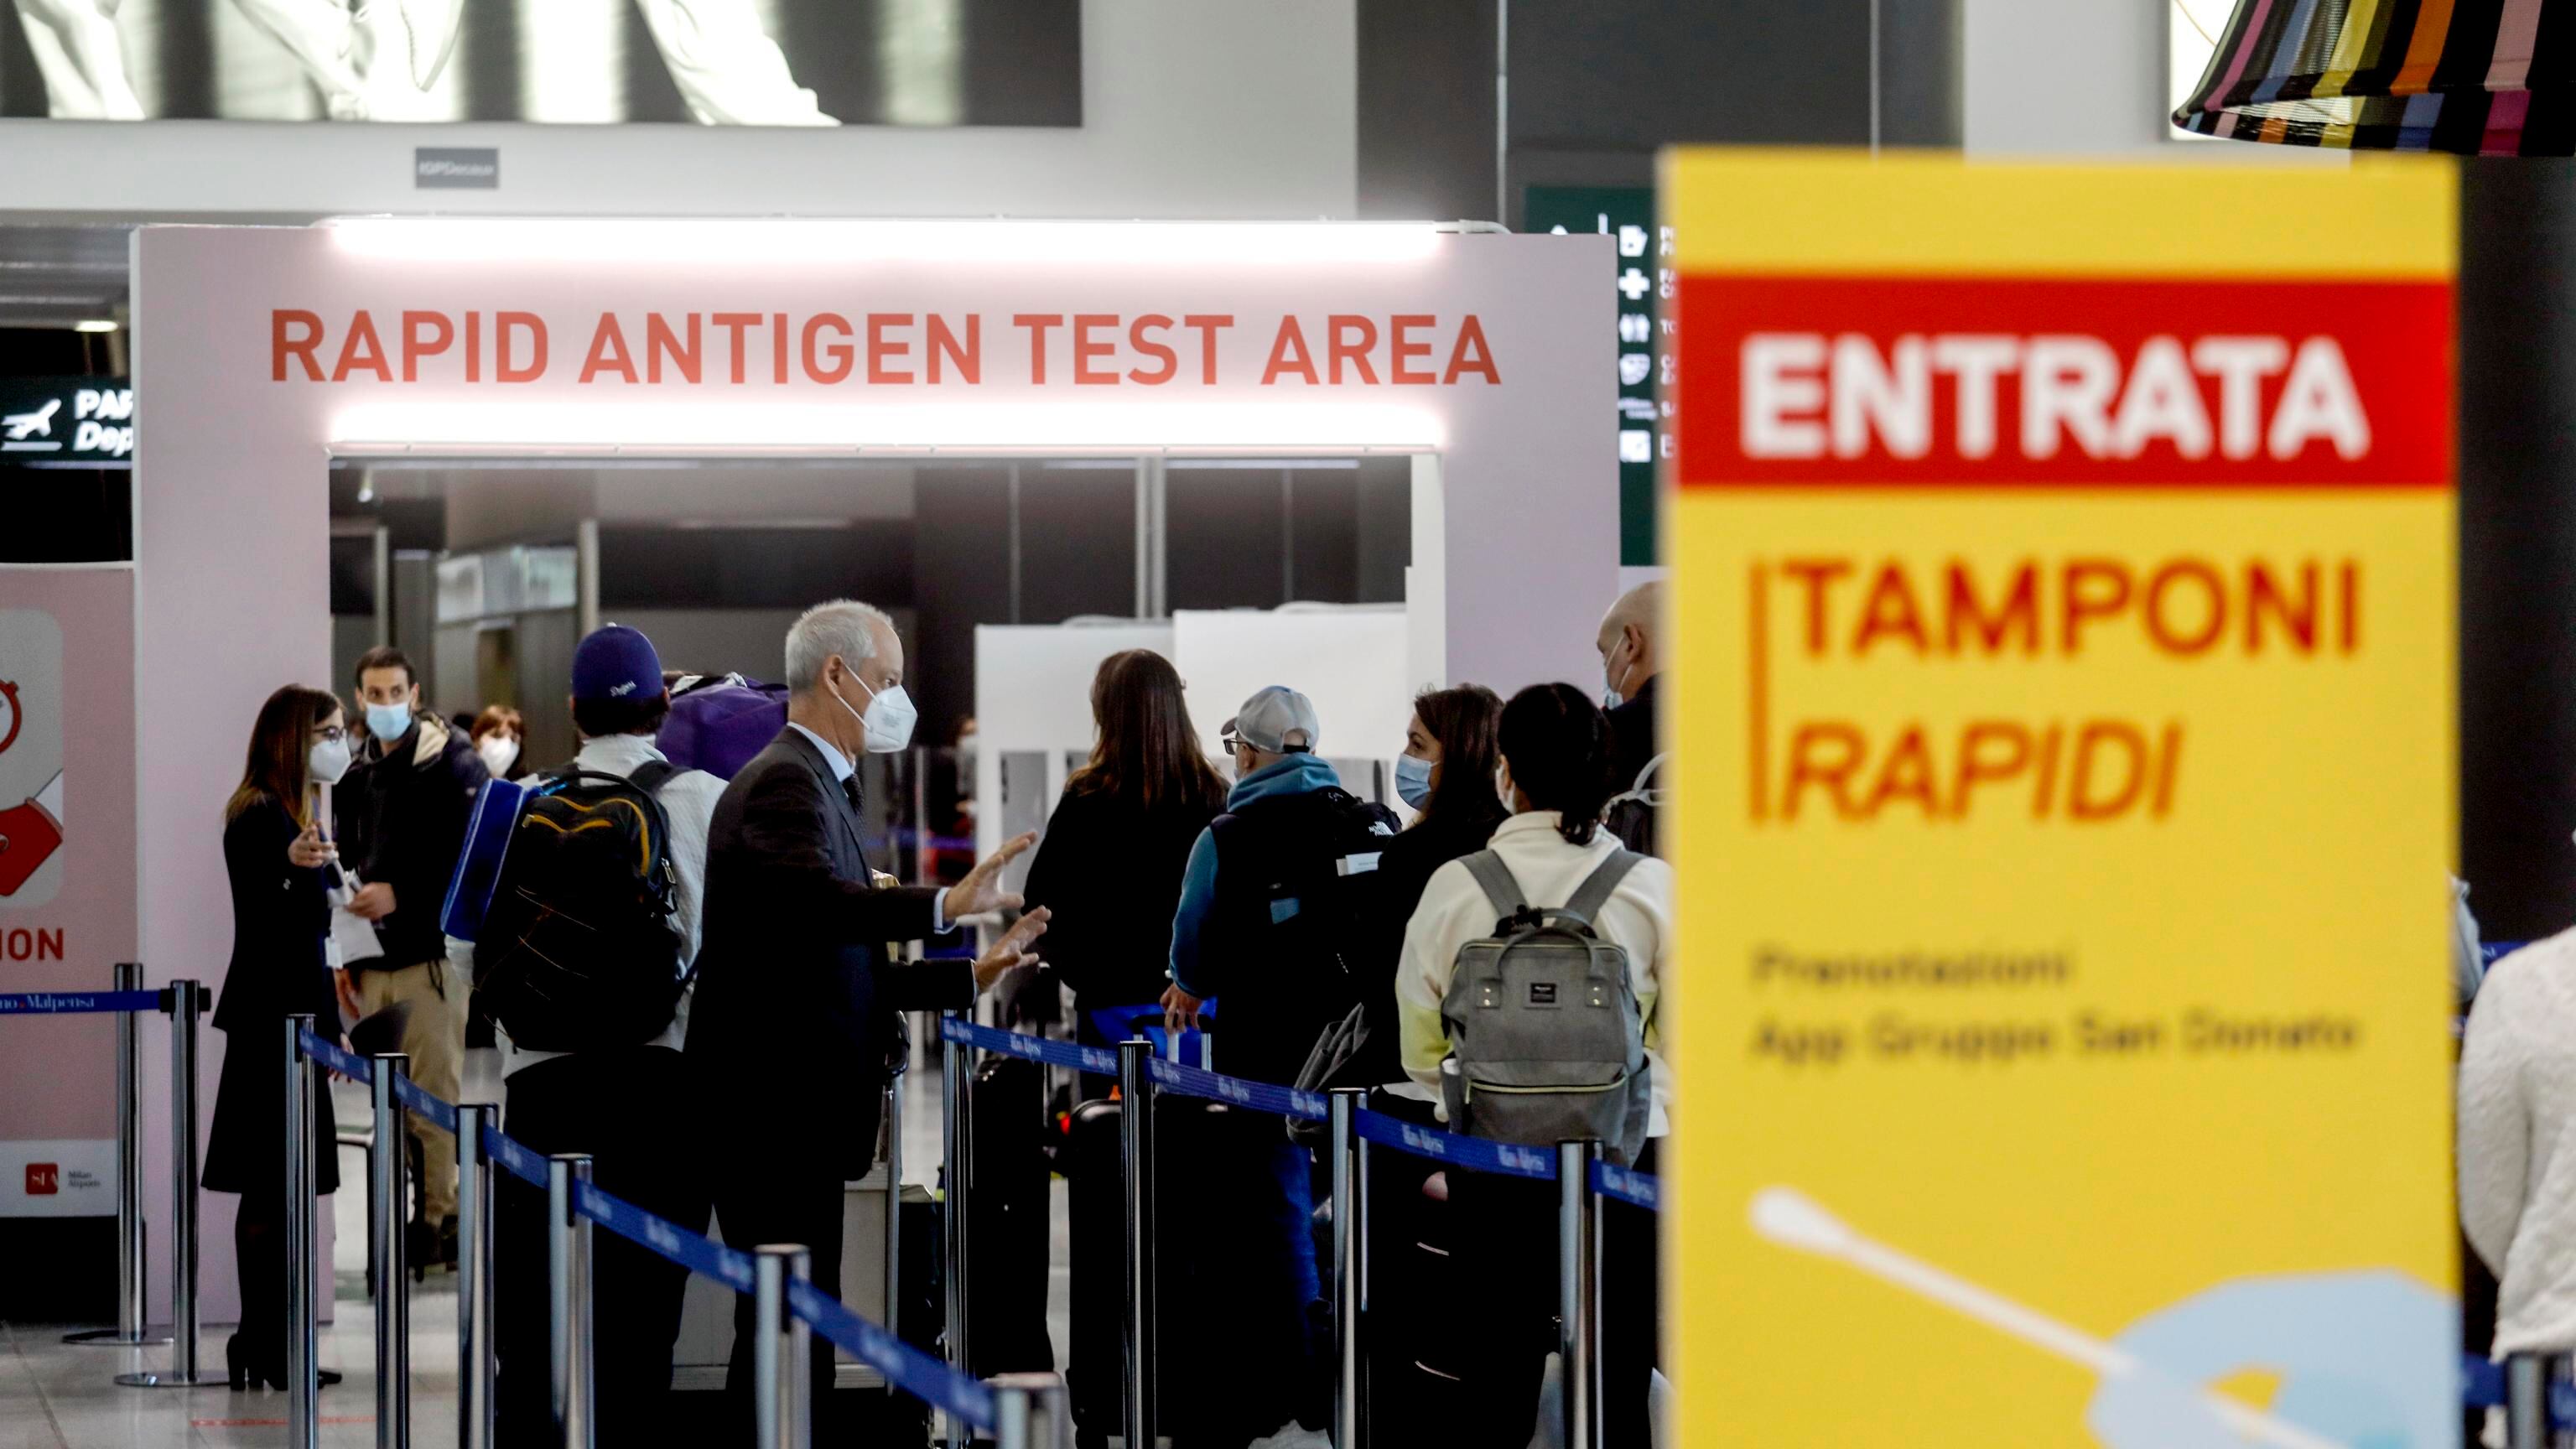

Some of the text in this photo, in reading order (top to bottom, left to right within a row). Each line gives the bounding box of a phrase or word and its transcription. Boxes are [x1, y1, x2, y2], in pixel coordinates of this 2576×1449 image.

[273, 309, 1501, 386] RAPID ANTIGEN TEST AREA
[1740, 334, 2370, 459] ENTRATA
[1779, 556, 2361, 660] TAMPONI
[1776, 719, 2184, 823] RAPIDI
[26, 994, 95, 1011] Malpensa
[1752, 1019, 1850, 1067] App
[2075, 1012, 2166, 1055] San
